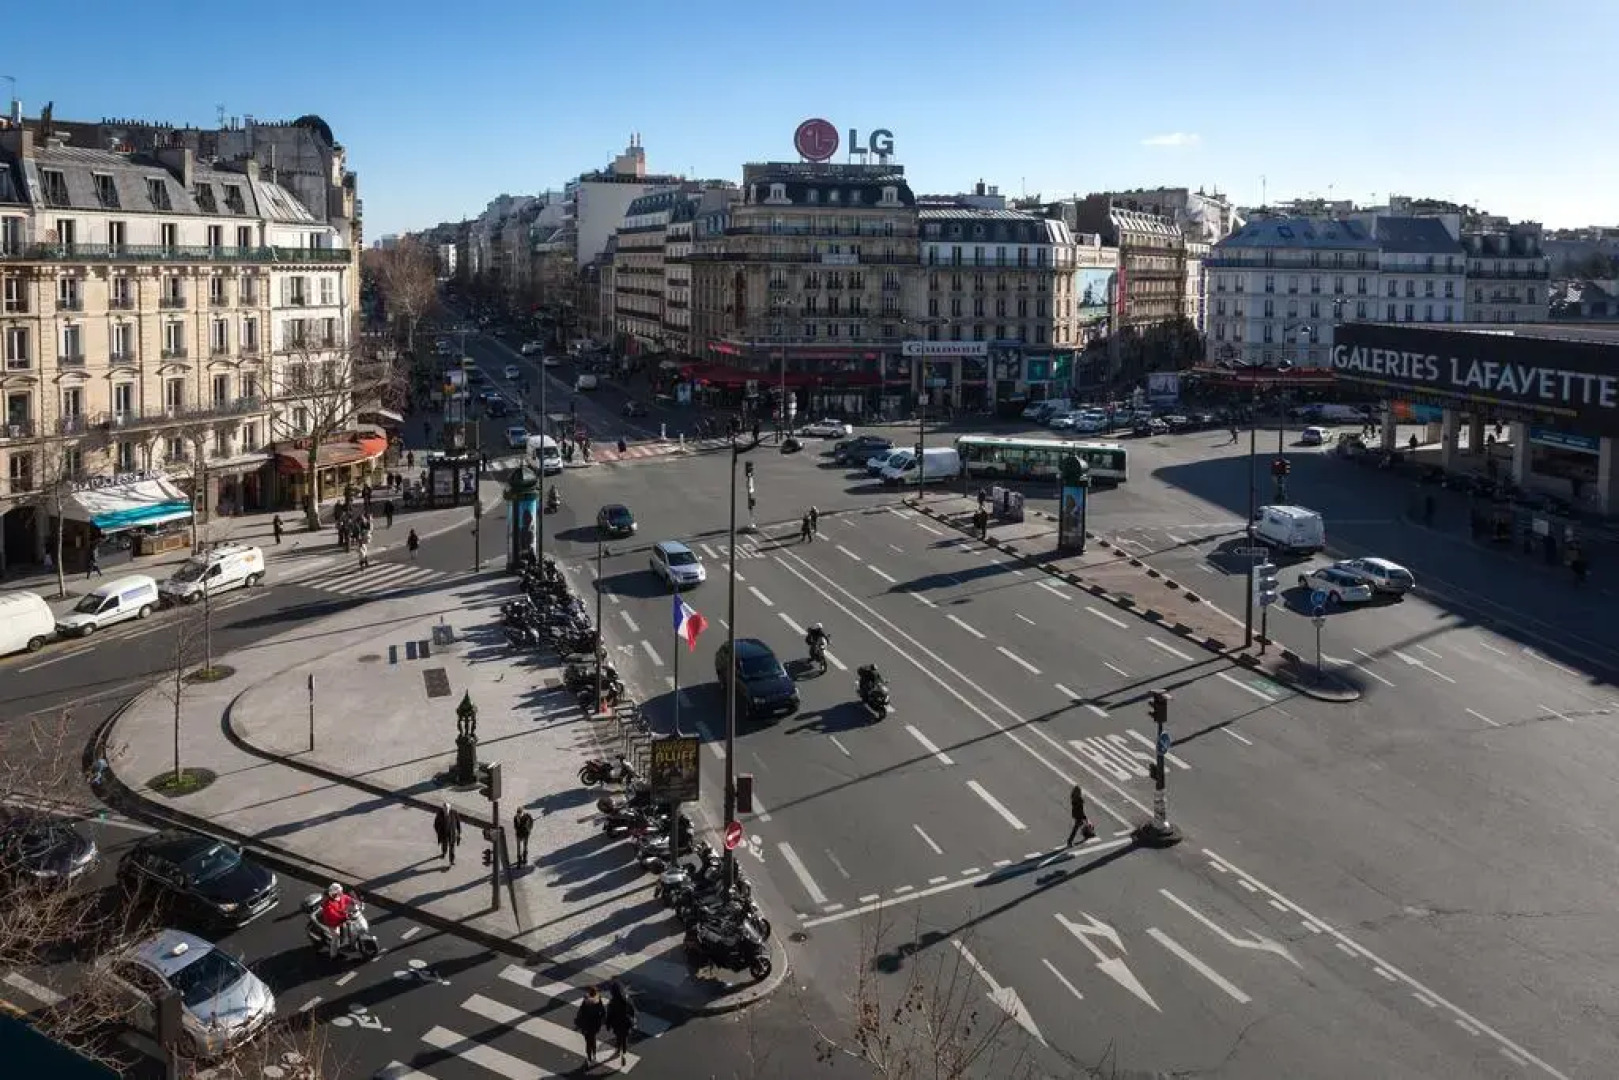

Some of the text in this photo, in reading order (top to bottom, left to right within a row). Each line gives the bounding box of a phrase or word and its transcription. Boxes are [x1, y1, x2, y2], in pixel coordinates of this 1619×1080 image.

[849, 129, 894, 155] LG
[1334, 345, 1618, 407] GALERIES LAFAYETTE
[1067, 734, 1169, 781] BUS
